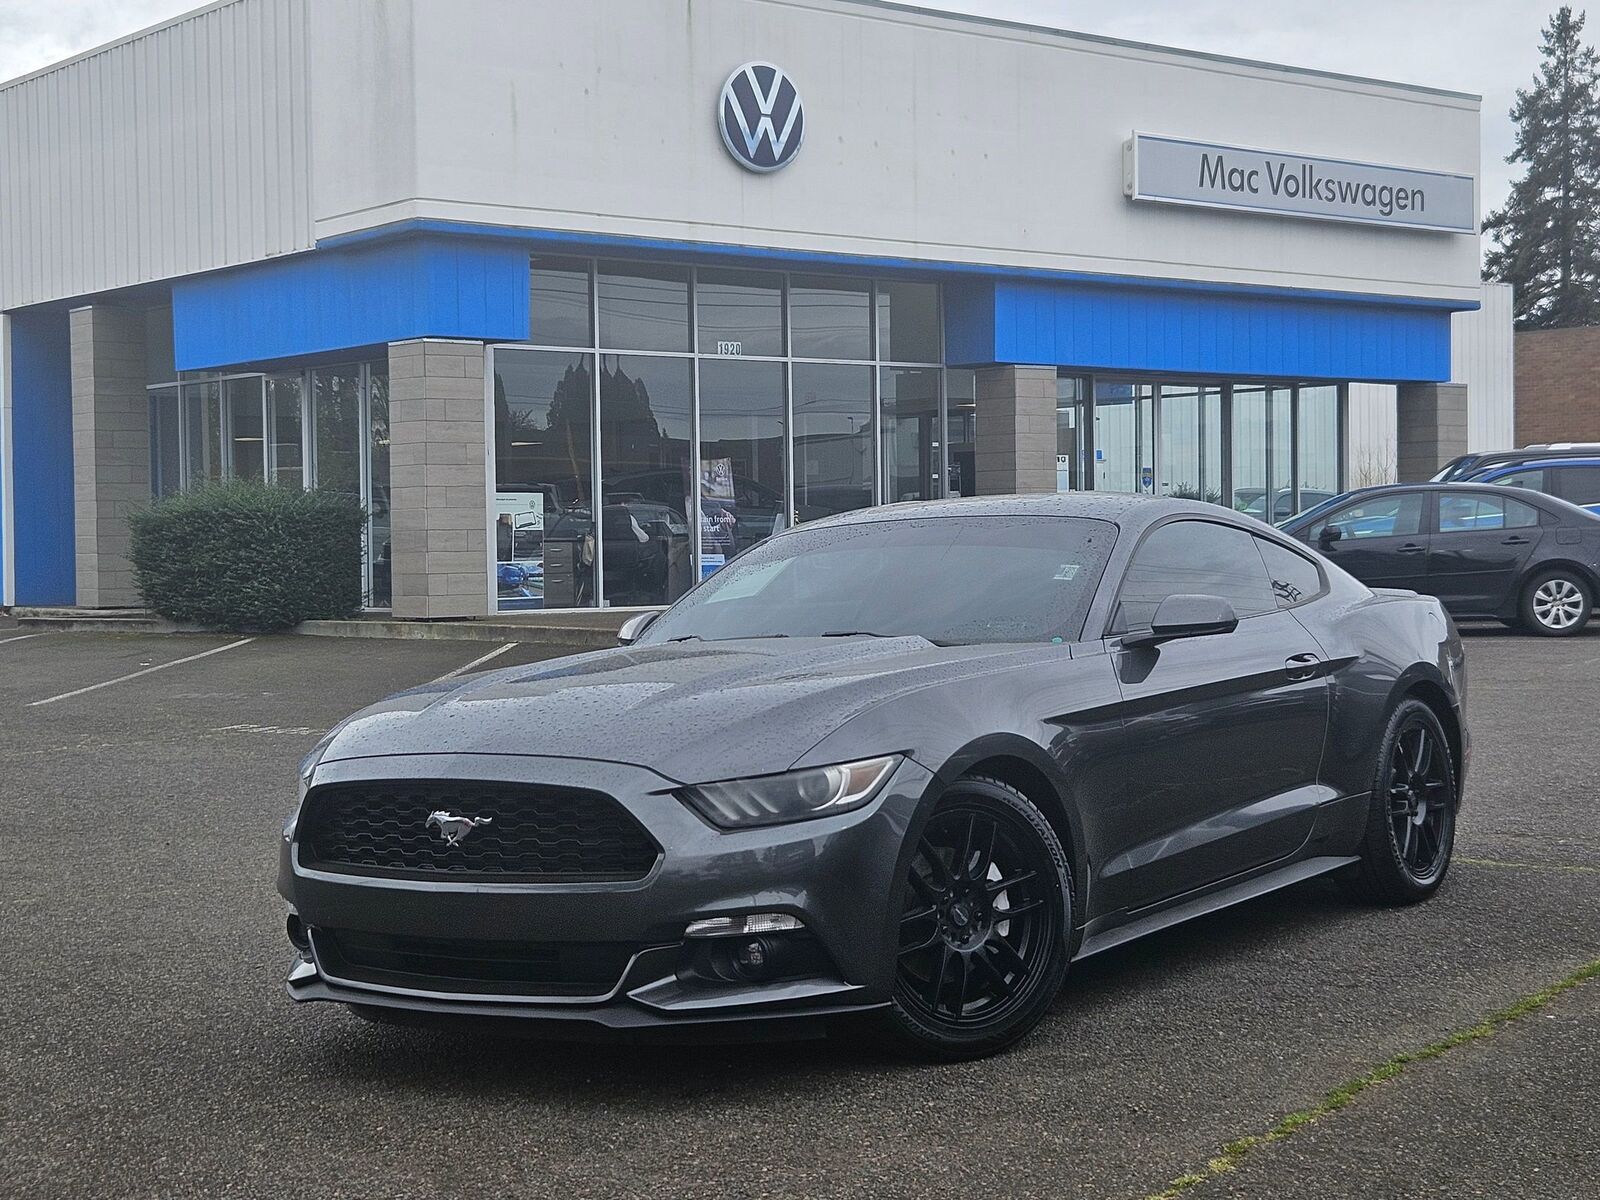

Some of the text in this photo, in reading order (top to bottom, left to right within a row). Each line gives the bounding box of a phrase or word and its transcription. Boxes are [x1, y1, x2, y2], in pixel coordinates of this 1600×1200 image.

[1198, 153, 1425, 217] Mac Volkswagen
[719, 343, 741, 356] 1920
[714, 514, 731, 523] from
